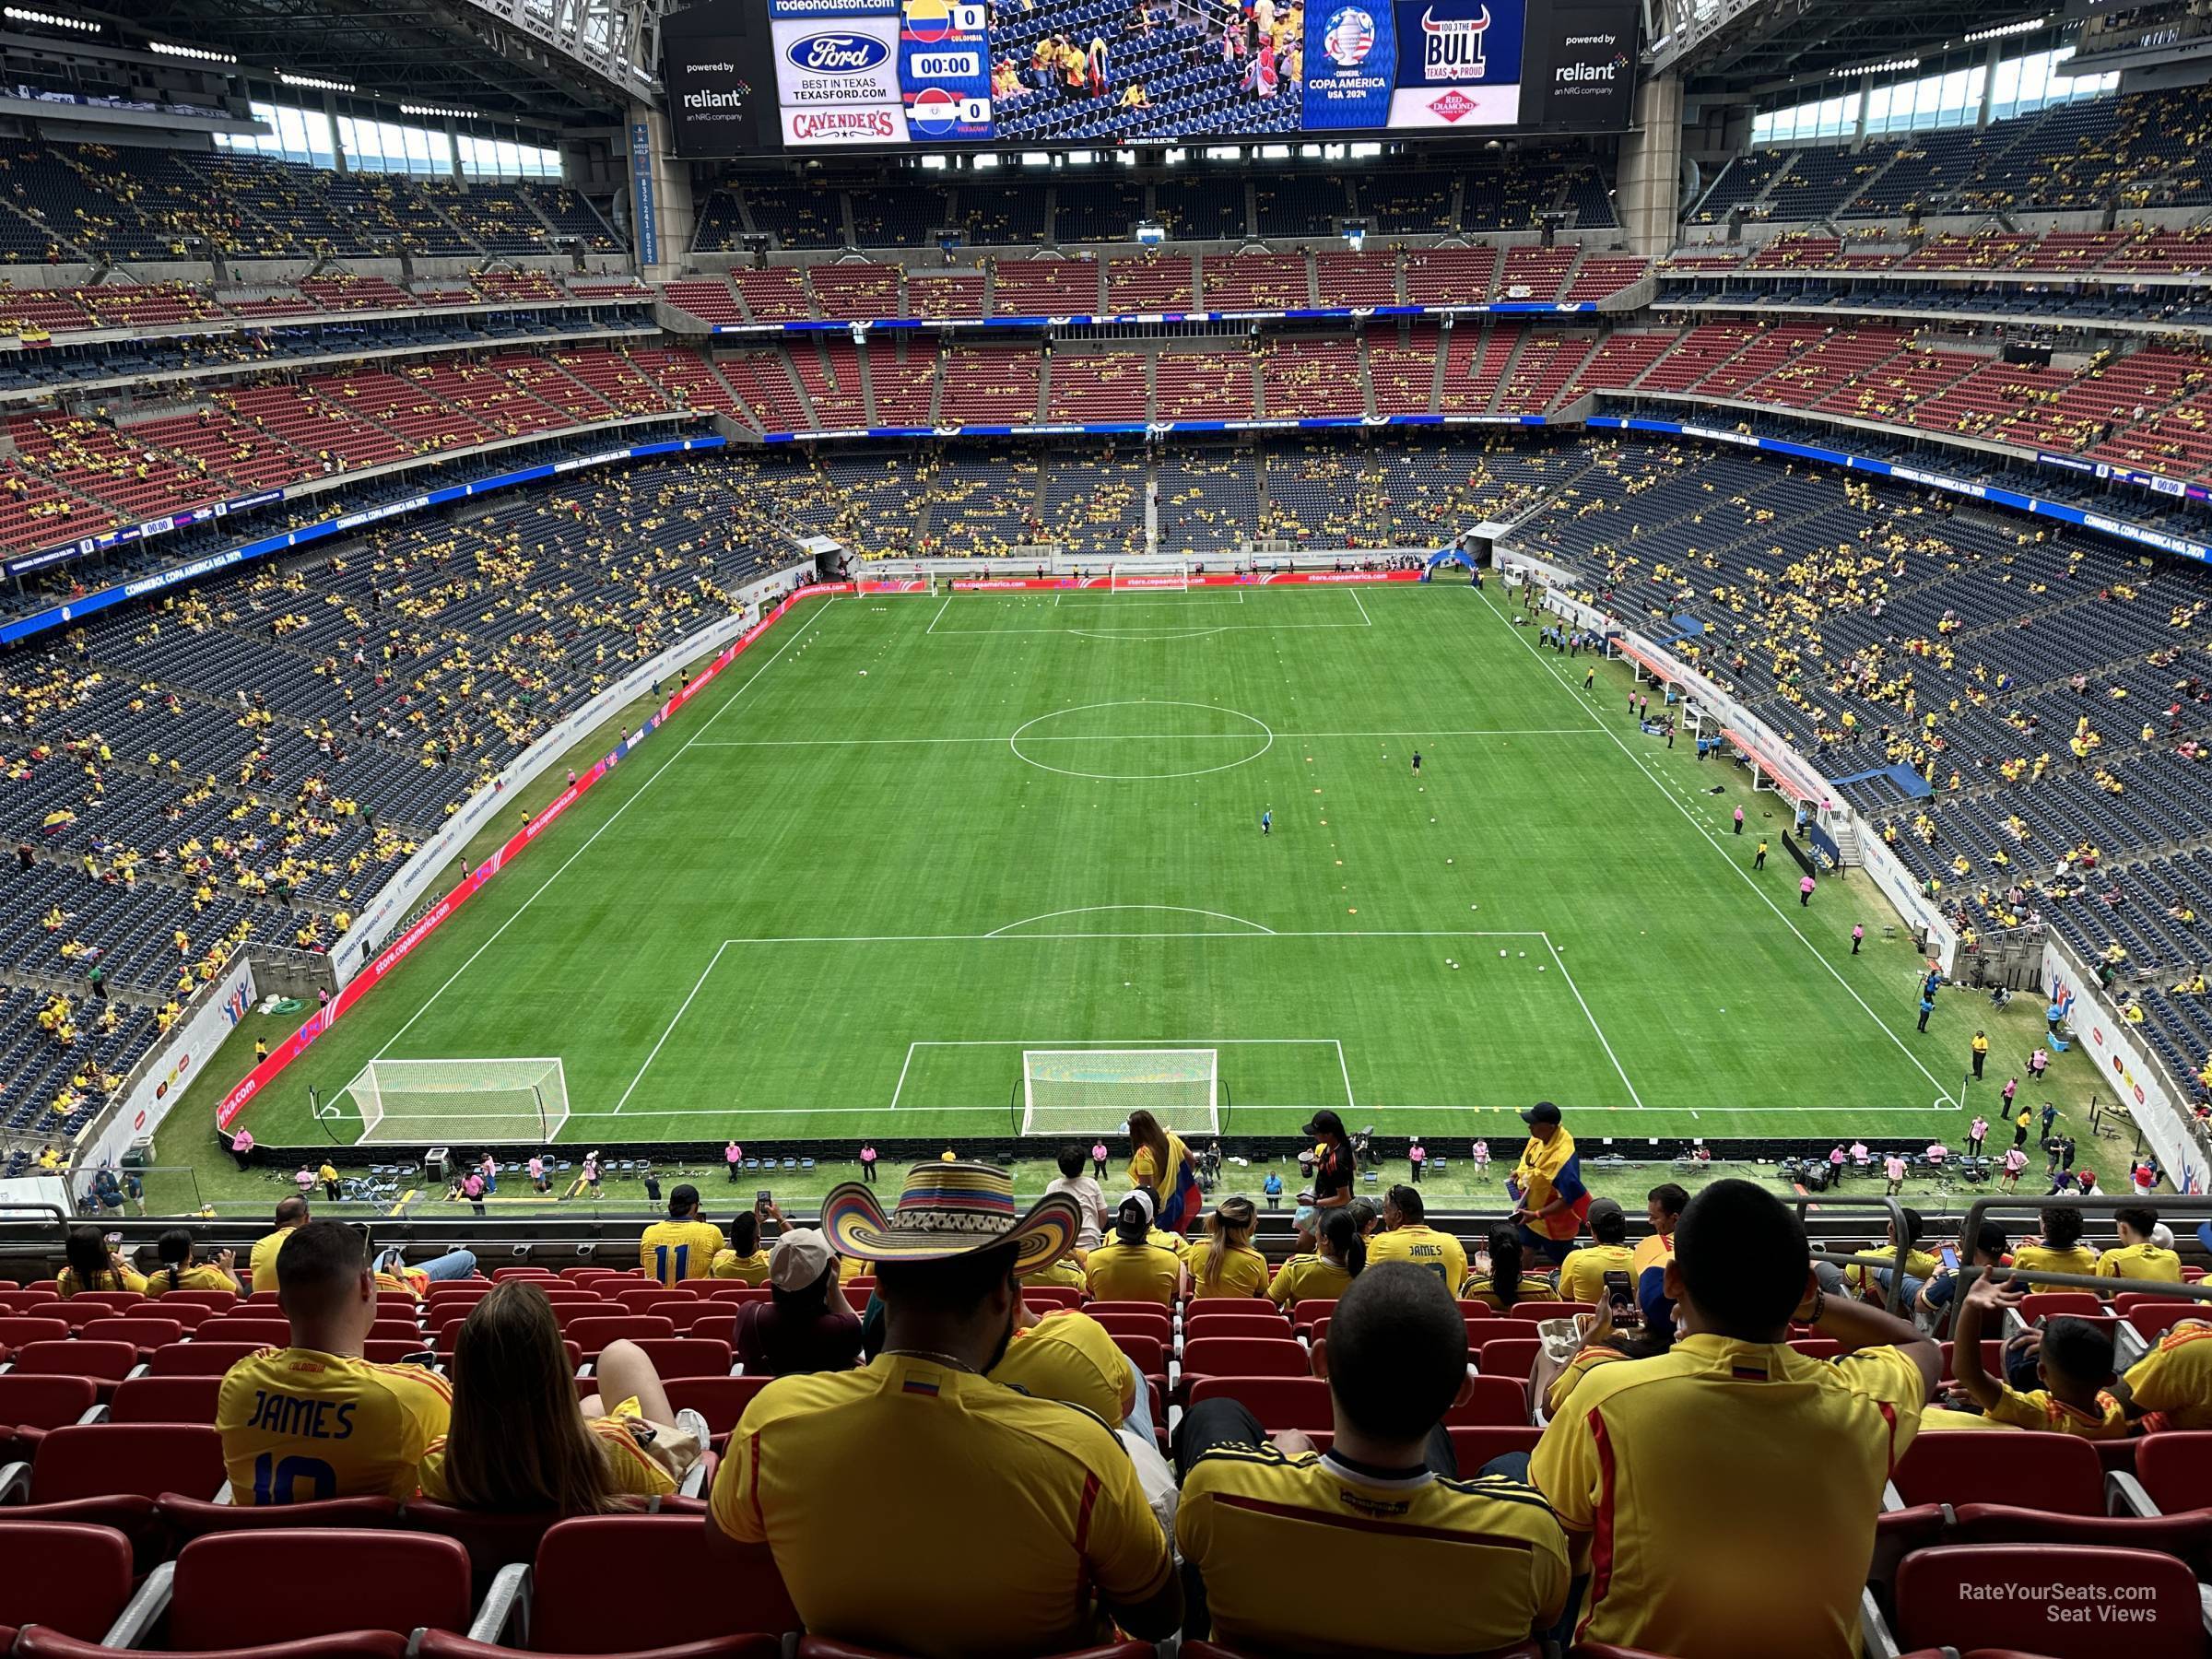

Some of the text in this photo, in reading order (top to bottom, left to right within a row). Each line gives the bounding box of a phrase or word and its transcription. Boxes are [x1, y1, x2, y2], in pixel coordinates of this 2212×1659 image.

[964, 10, 975, 26] 0
[1441, 22, 1469, 31] 100.3 THE
[1565, 34, 1616, 46] powered by
[807, 38, 869, 67] Ford
[1428, 32, 1484, 65] BULL
[687, 62, 734, 74] powered by
[921, 57, 970, 74] 00:00
[1427, 66, 1483, 76] TEXAS PROUD
[1556, 62, 1615, 81] reliant
[802, 77, 877, 89] BEST IN TEXAS
[1309, 77, 1385, 89] COPA AMERICA
[683, 89, 741, 107] reliant
[793, 88, 887, 100] TEXASFORD.COM
[1347, 90, 1366, 99] 2024
[1564, 87, 1580, 95] NRG
[1581, 87, 1613, 95] company
[970, 103, 980, 119] 0
[793, 110, 893, 138] CAVENDER'S
[2158, 480, 2179, 492] 00:00
[218, 504, 224, 513] 0
[147, 521, 168, 534] 00:00
[2084, 514, 2206, 559] CONMEBOL COPA AMERICA USA 2024
[125, 550, 242, 596] CONMEBOL COPA AMERICA USA 2024
[375, 902, 450, 974] store.copaamerica.com
[1409, 1245, 1442, 1256] JAMES
[654, 1243, 689, 1285] 11
[247, 1390, 357, 1440] JAMES
